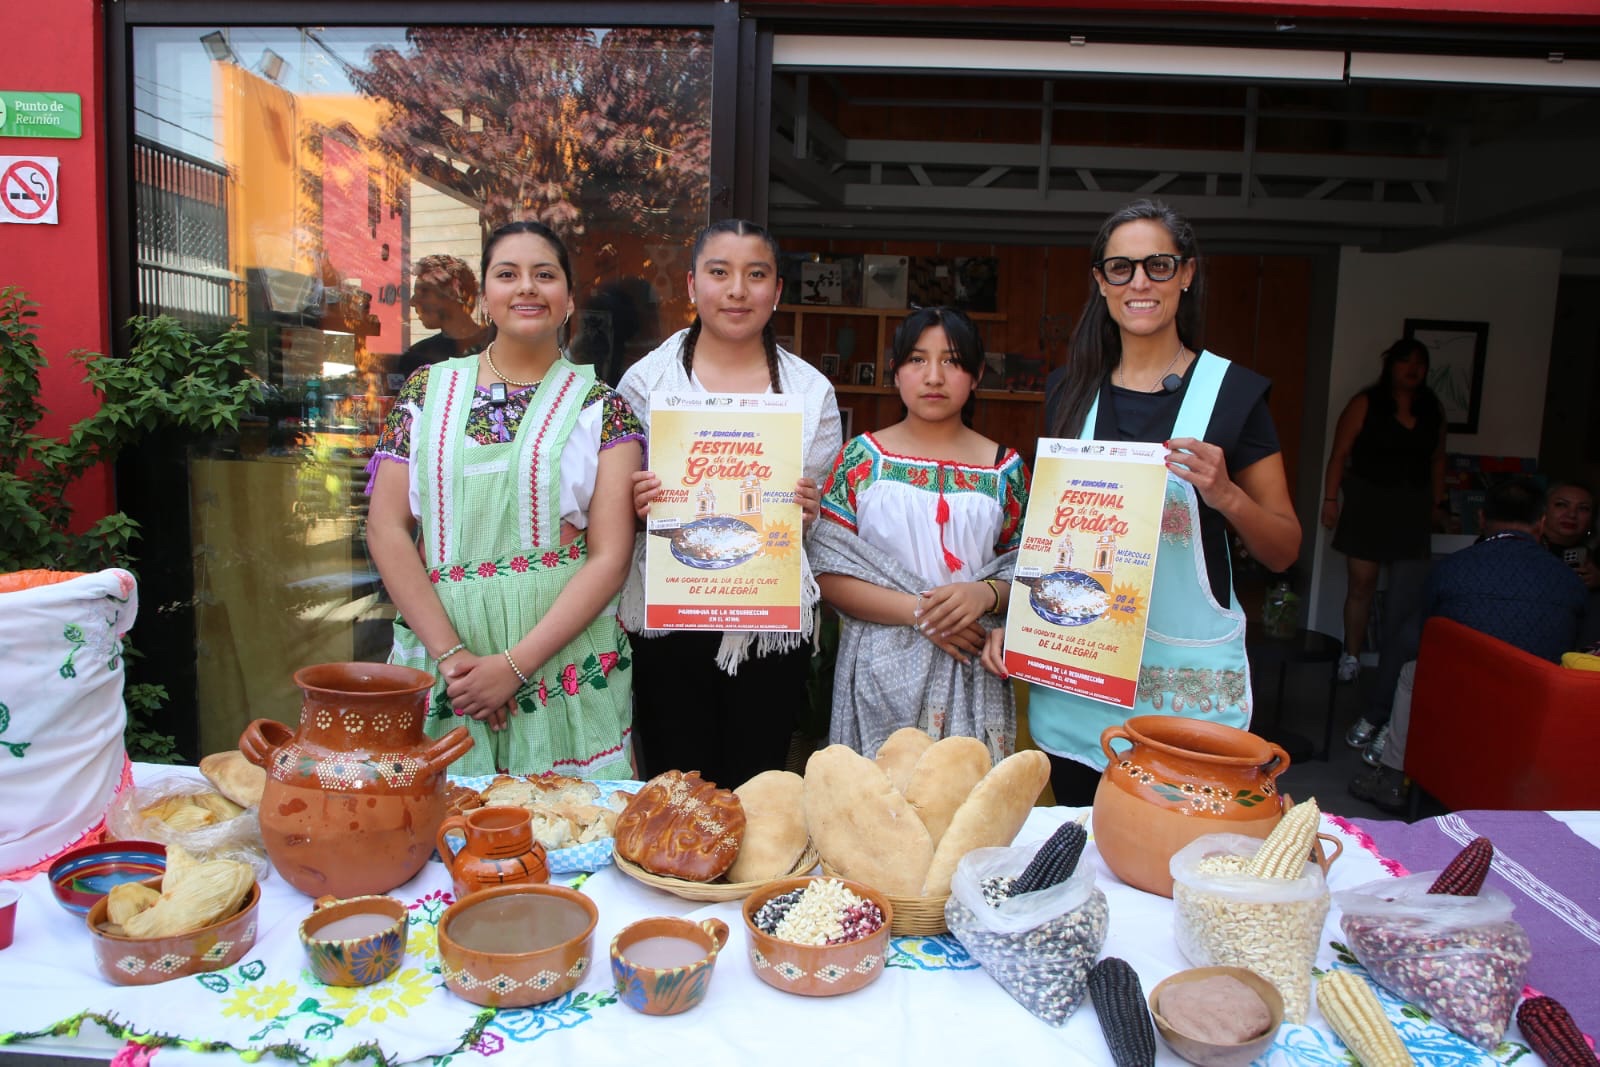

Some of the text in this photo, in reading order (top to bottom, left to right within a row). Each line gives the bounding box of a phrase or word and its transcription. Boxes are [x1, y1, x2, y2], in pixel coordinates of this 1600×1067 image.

[15, 100, 64, 112] Punto de
[16, 113, 60, 125] Reunión
[712, 429, 742, 438] EDICIÓN
[690, 440, 764, 455] FESTIVAL
[727, 456, 737, 464] la
[682, 457, 772, 486] Gordita
[1061, 489, 1125, 509] FESTIVAL
[1078, 507, 1088, 515] de
[1049, 506, 1129, 538] Gordita
[1026, 536, 1053, 546] ENTRADA
[1023, 544, 1051, 552] GRATUITA
[1117, 549, 1151, 560] MIÉRCOLES
[1133, 558, 1149, 567] ABRIL
[689, 584, 758, 595] DE LA ALEGRÍA
[1034, 628, 1056, 638] GORDITA
[1098, 642, 1119, 653] CLAVE
[1039, 639, 1098, 660] DE LA ALEGRÍA
